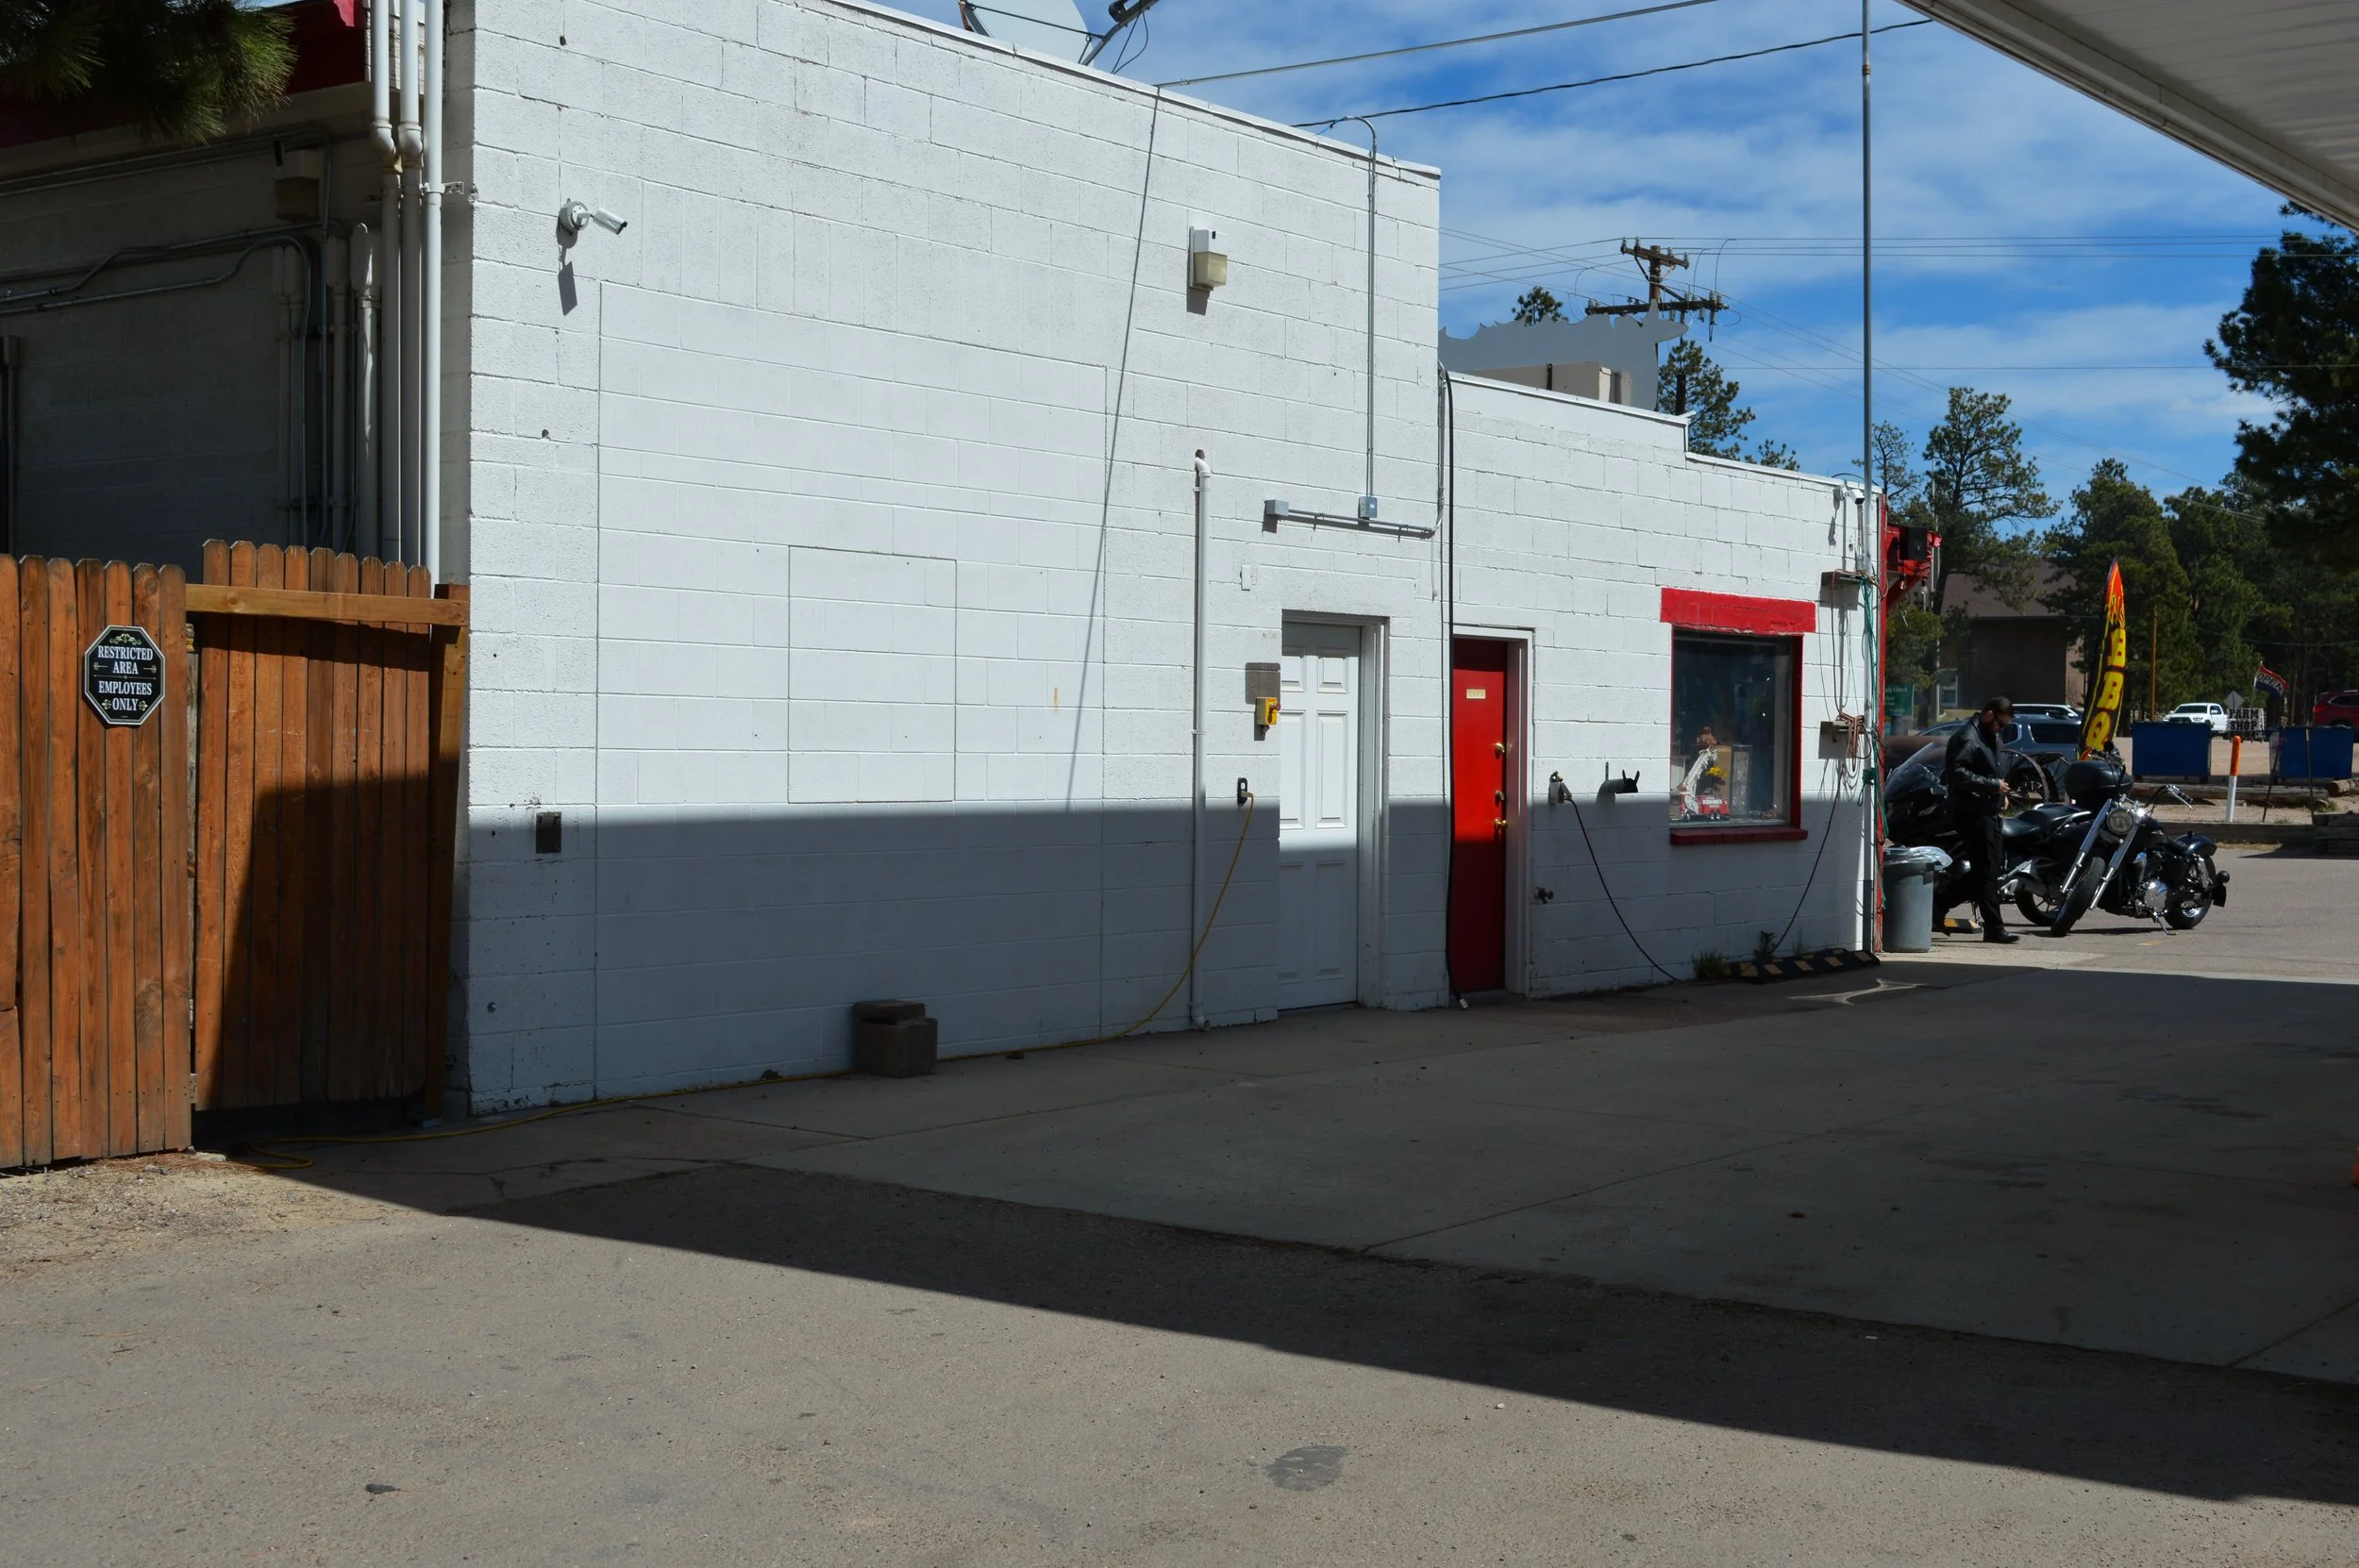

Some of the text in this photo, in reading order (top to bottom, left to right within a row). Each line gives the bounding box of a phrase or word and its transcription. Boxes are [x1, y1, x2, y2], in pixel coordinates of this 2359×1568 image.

[98, 645, 153, 660] RESTRICTED
[113, 661, 139, 675] AREA
[98, 681, 152, 695] EMPLOYEES
[2086, 627, 2126, 752] BBQ
[2257, 674, 2284, 691] OPEN
[112, 698, 139, 710] ONLY
[2230, 720, 2257, 730] SHOP
